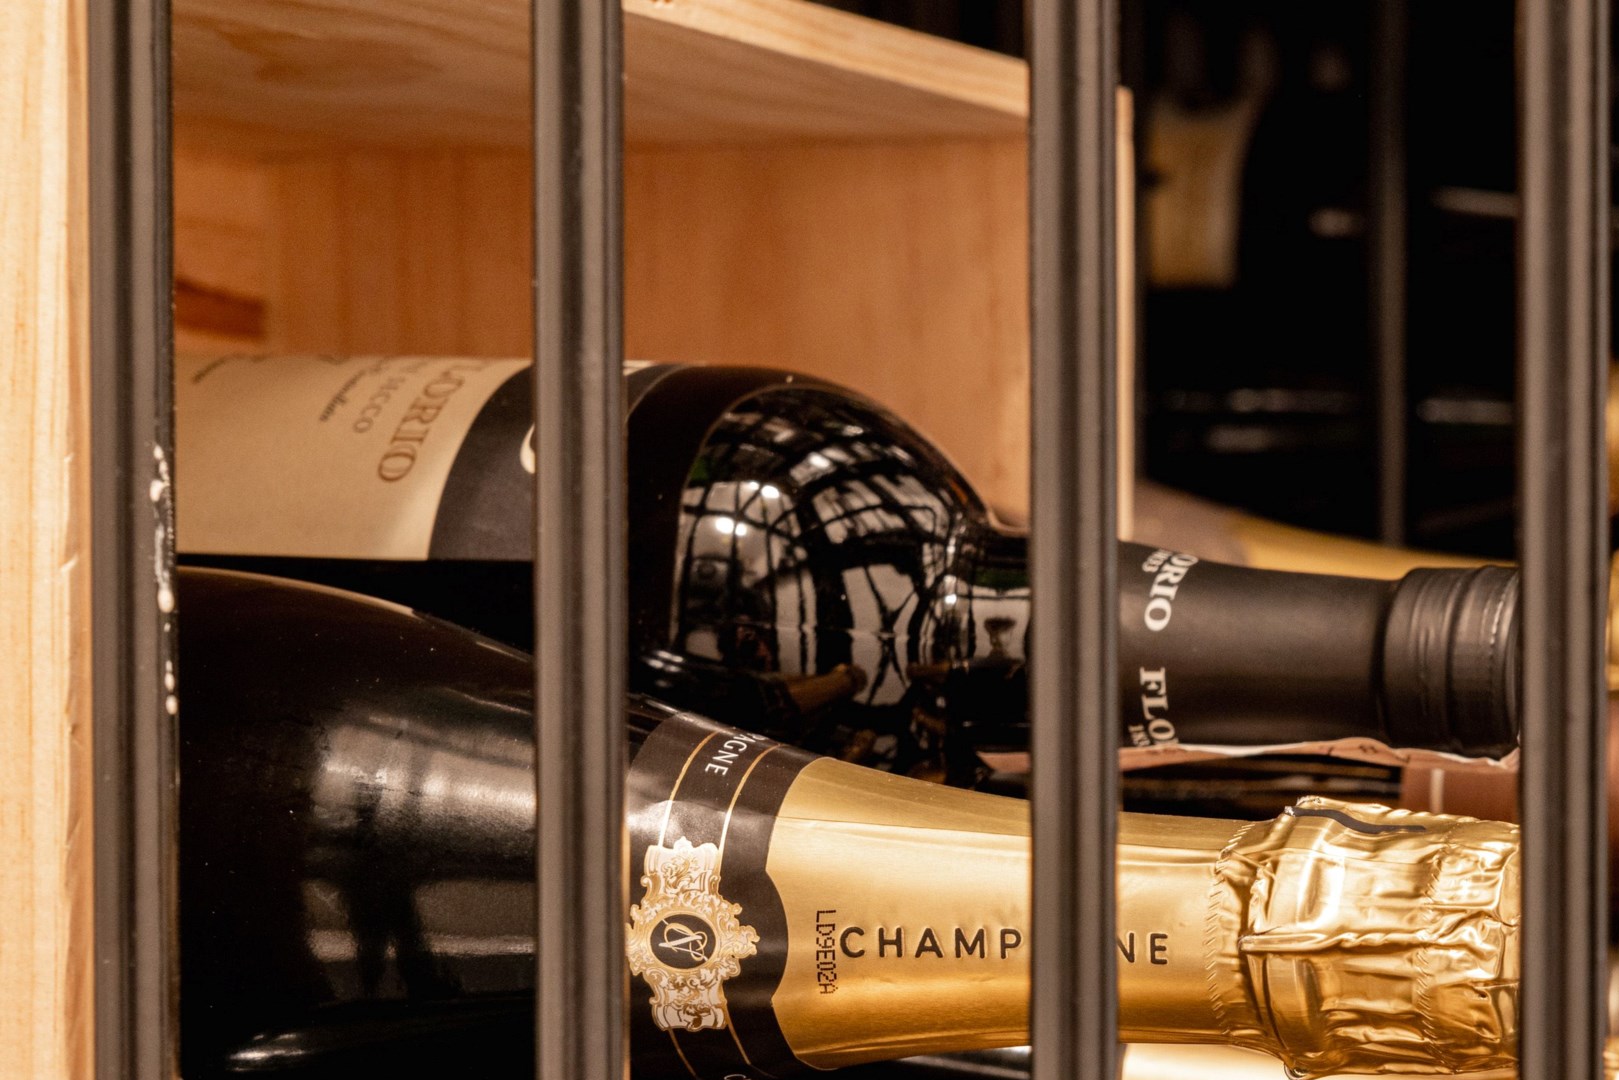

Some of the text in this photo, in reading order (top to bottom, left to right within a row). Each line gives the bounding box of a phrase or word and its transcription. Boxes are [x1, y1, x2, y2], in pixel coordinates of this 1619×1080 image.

[1143, 553, 1199, 632] ORIO
[1139, 666, 1179, 746] FLO
[839, 926, 1169, 965] CHAMPNE
